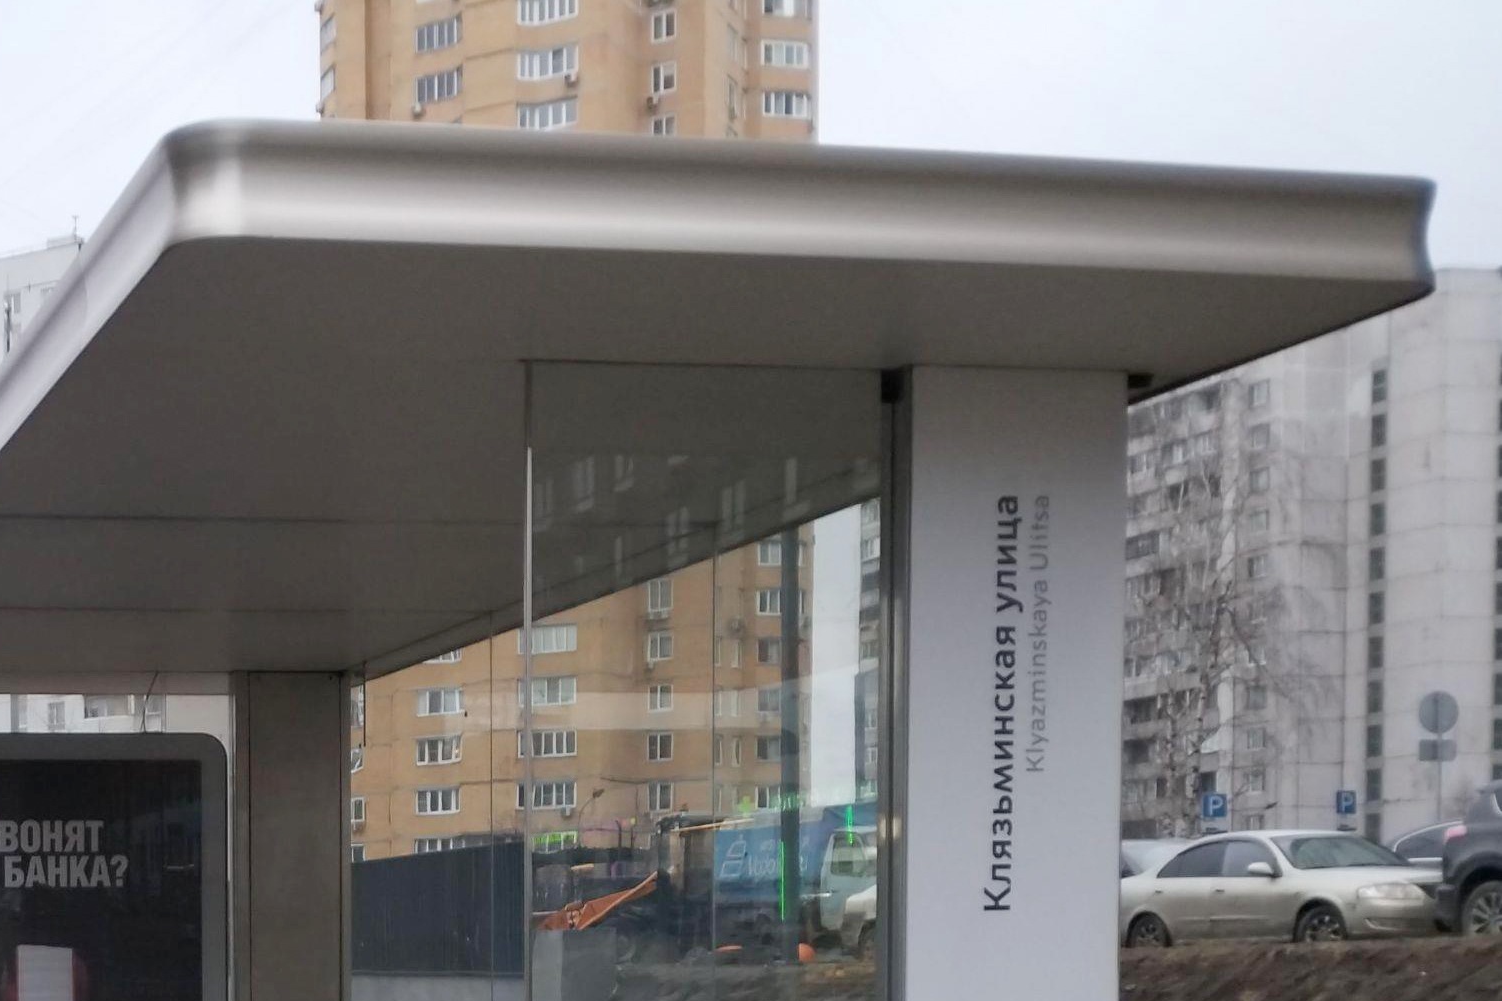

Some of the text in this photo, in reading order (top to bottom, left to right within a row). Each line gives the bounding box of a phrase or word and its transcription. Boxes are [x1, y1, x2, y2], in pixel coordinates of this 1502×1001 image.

[983, 495, 1023, 911] Клязьминская улица
[1025, 495, 1052, 773] Klyazminskaya Ulitsa
[4, 854, 129, 888] БАНКА?
